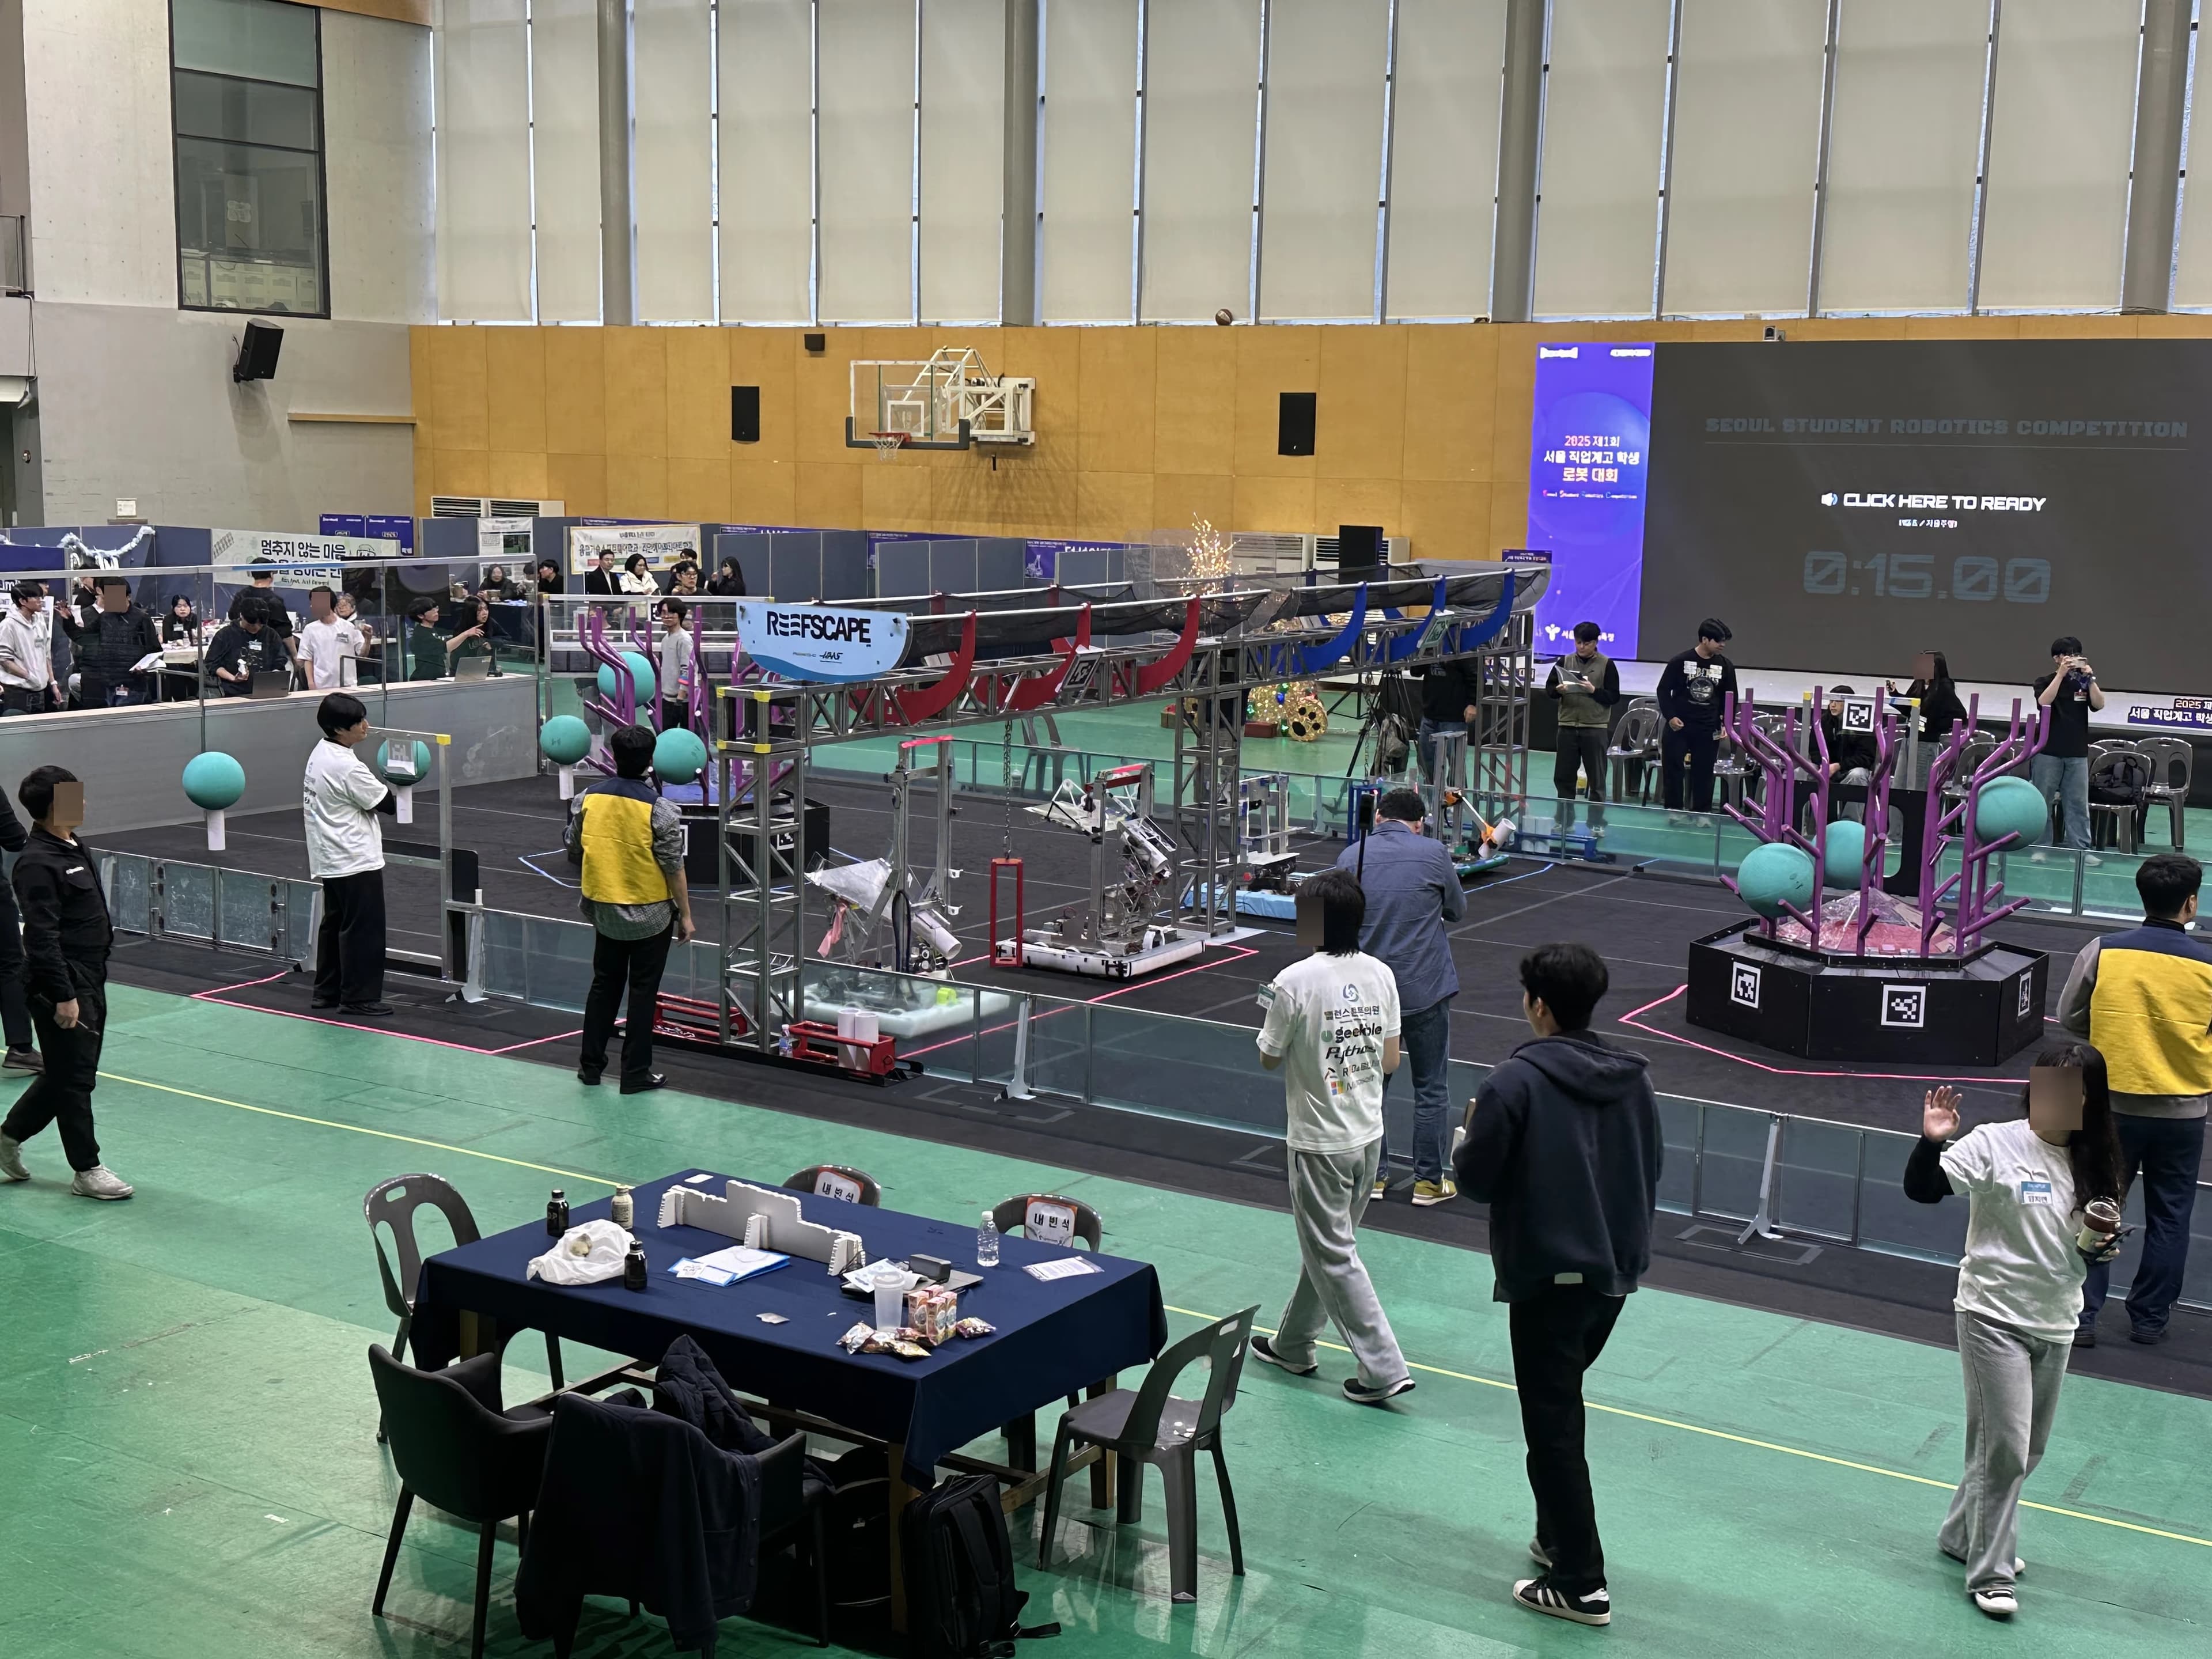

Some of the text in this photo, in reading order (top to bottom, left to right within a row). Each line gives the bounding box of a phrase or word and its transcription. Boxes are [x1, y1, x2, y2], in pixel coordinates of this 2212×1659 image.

[1705, 418, 2188, 437] SEOUL STUDENT ROBOTICS COMPETITION
[1564, 435, 1620, 448] 2025 제1회
[1544, 451, 1640, 465] 서울 직업계고 학생
[1562, 468, 1618, 483] 로봇 대회
[1843, 493, 2047, 512] CLICK HERE TO READY
[261, 539, 346, 560] 멈추지 않는 마음
[1803, 550, 2051, 604] 0:15.00
[766, 611, 872, 643] REEFSCAPE
[2175, 699, 2202, 709] 2025
[2130, 707, 2150, 719] 서울
[2153, 709, 2192, 722] 직업계고
